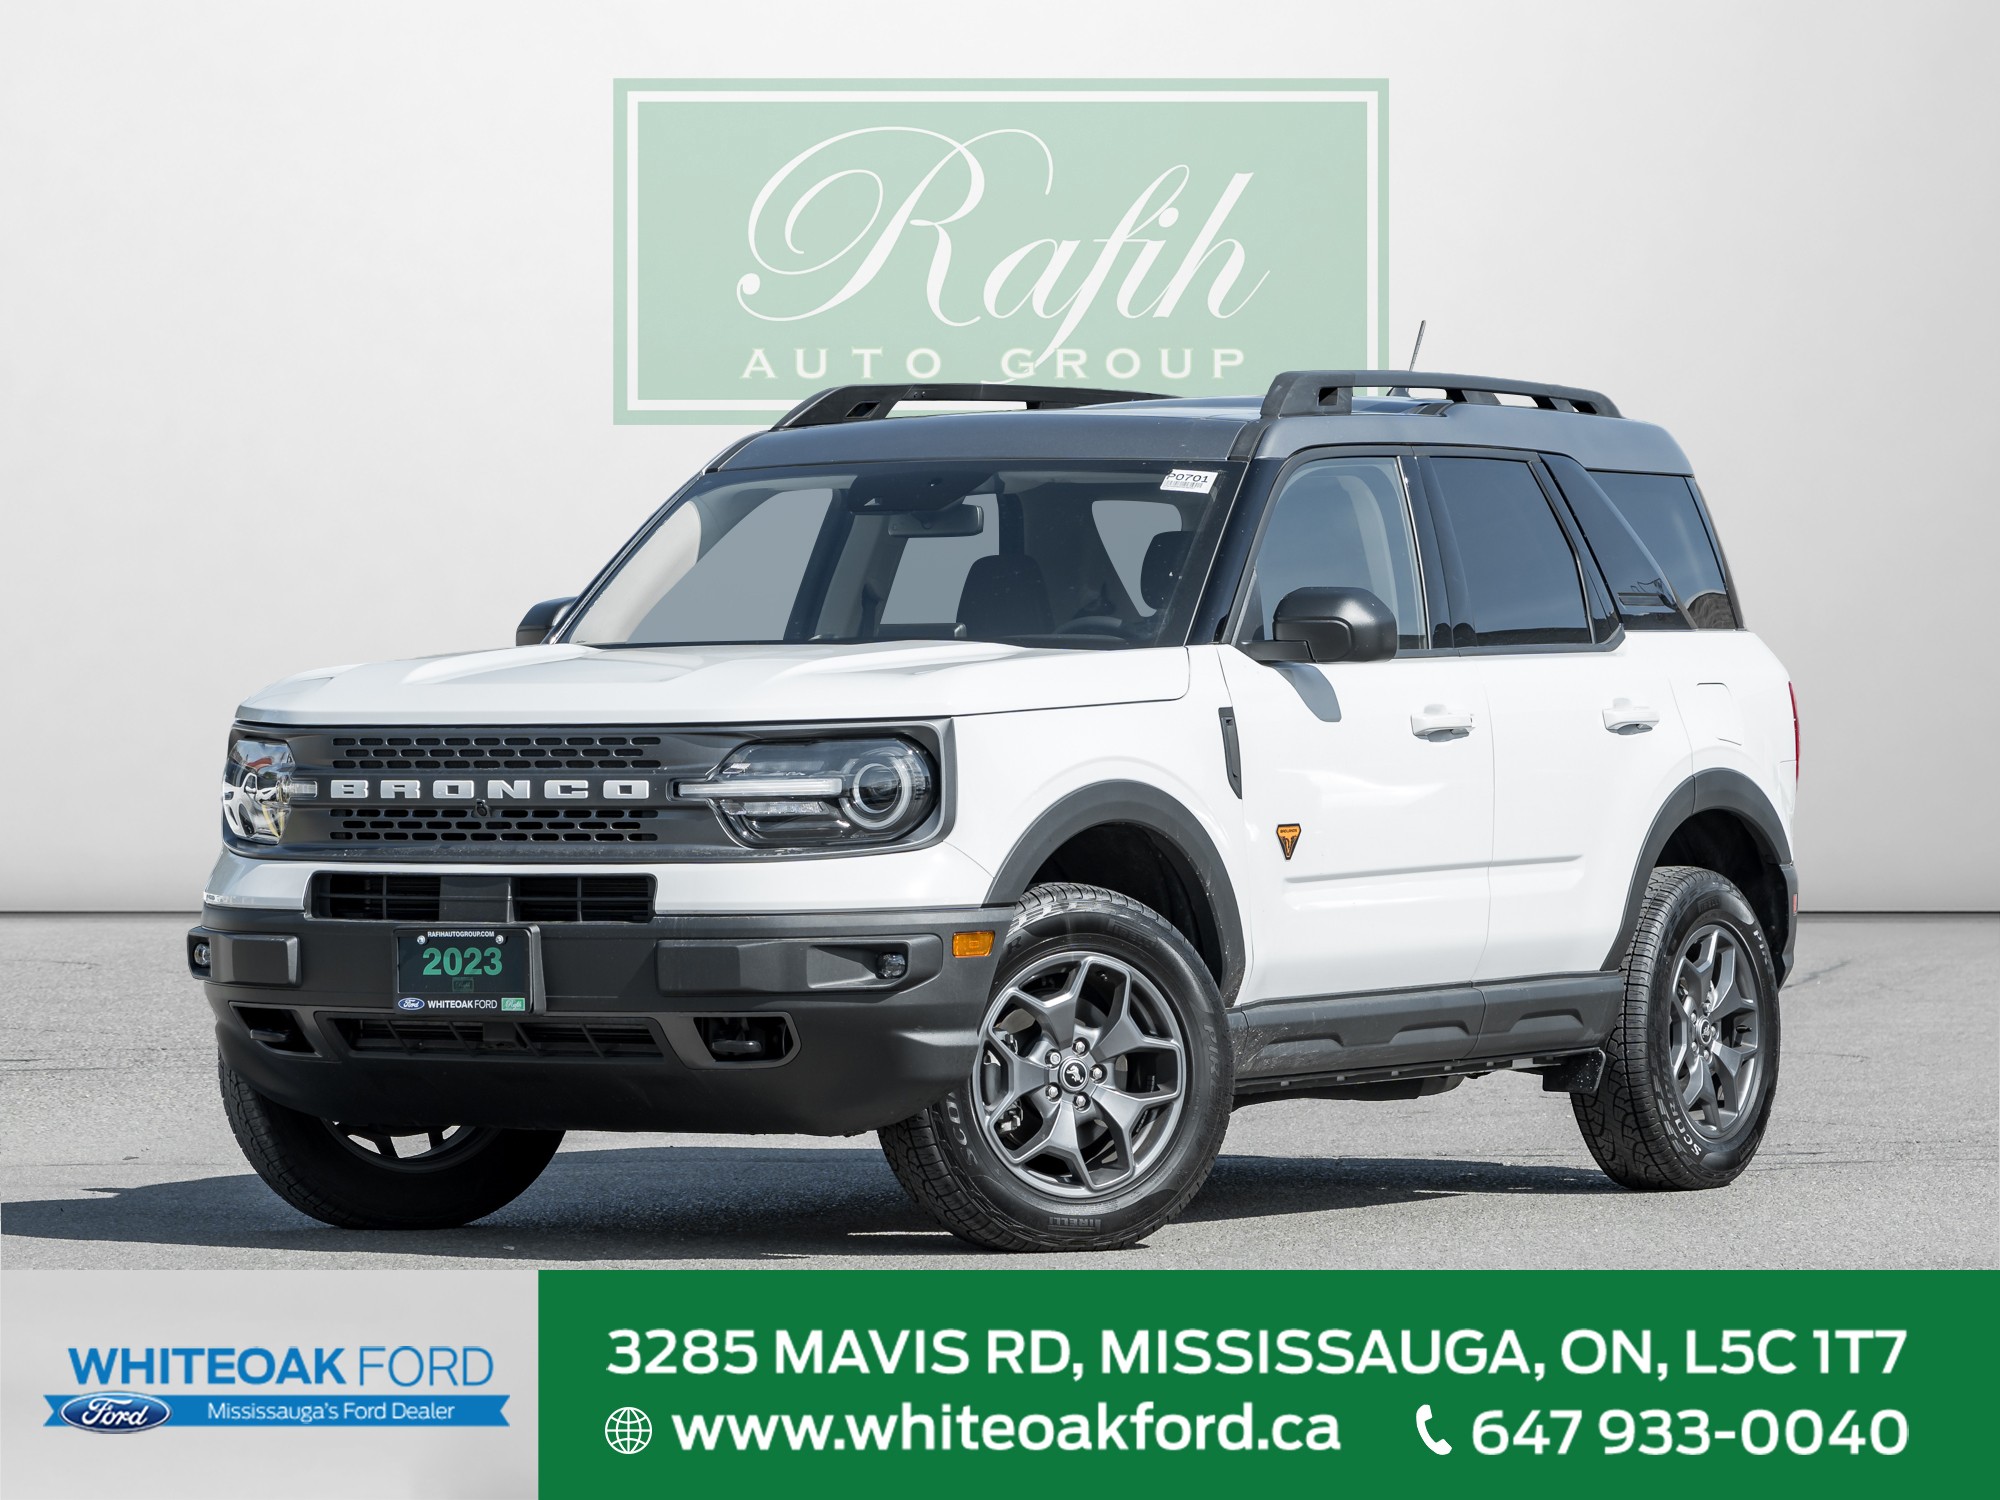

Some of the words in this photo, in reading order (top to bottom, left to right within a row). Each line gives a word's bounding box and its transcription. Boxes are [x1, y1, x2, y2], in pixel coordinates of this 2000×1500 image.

[330, 779, 650, 800] BRONCO
[422, 947, 503, 976] 2023
[427, 1000, 473, 1009] WHITEOAK
[474, 999, 498, 1009] FORD
